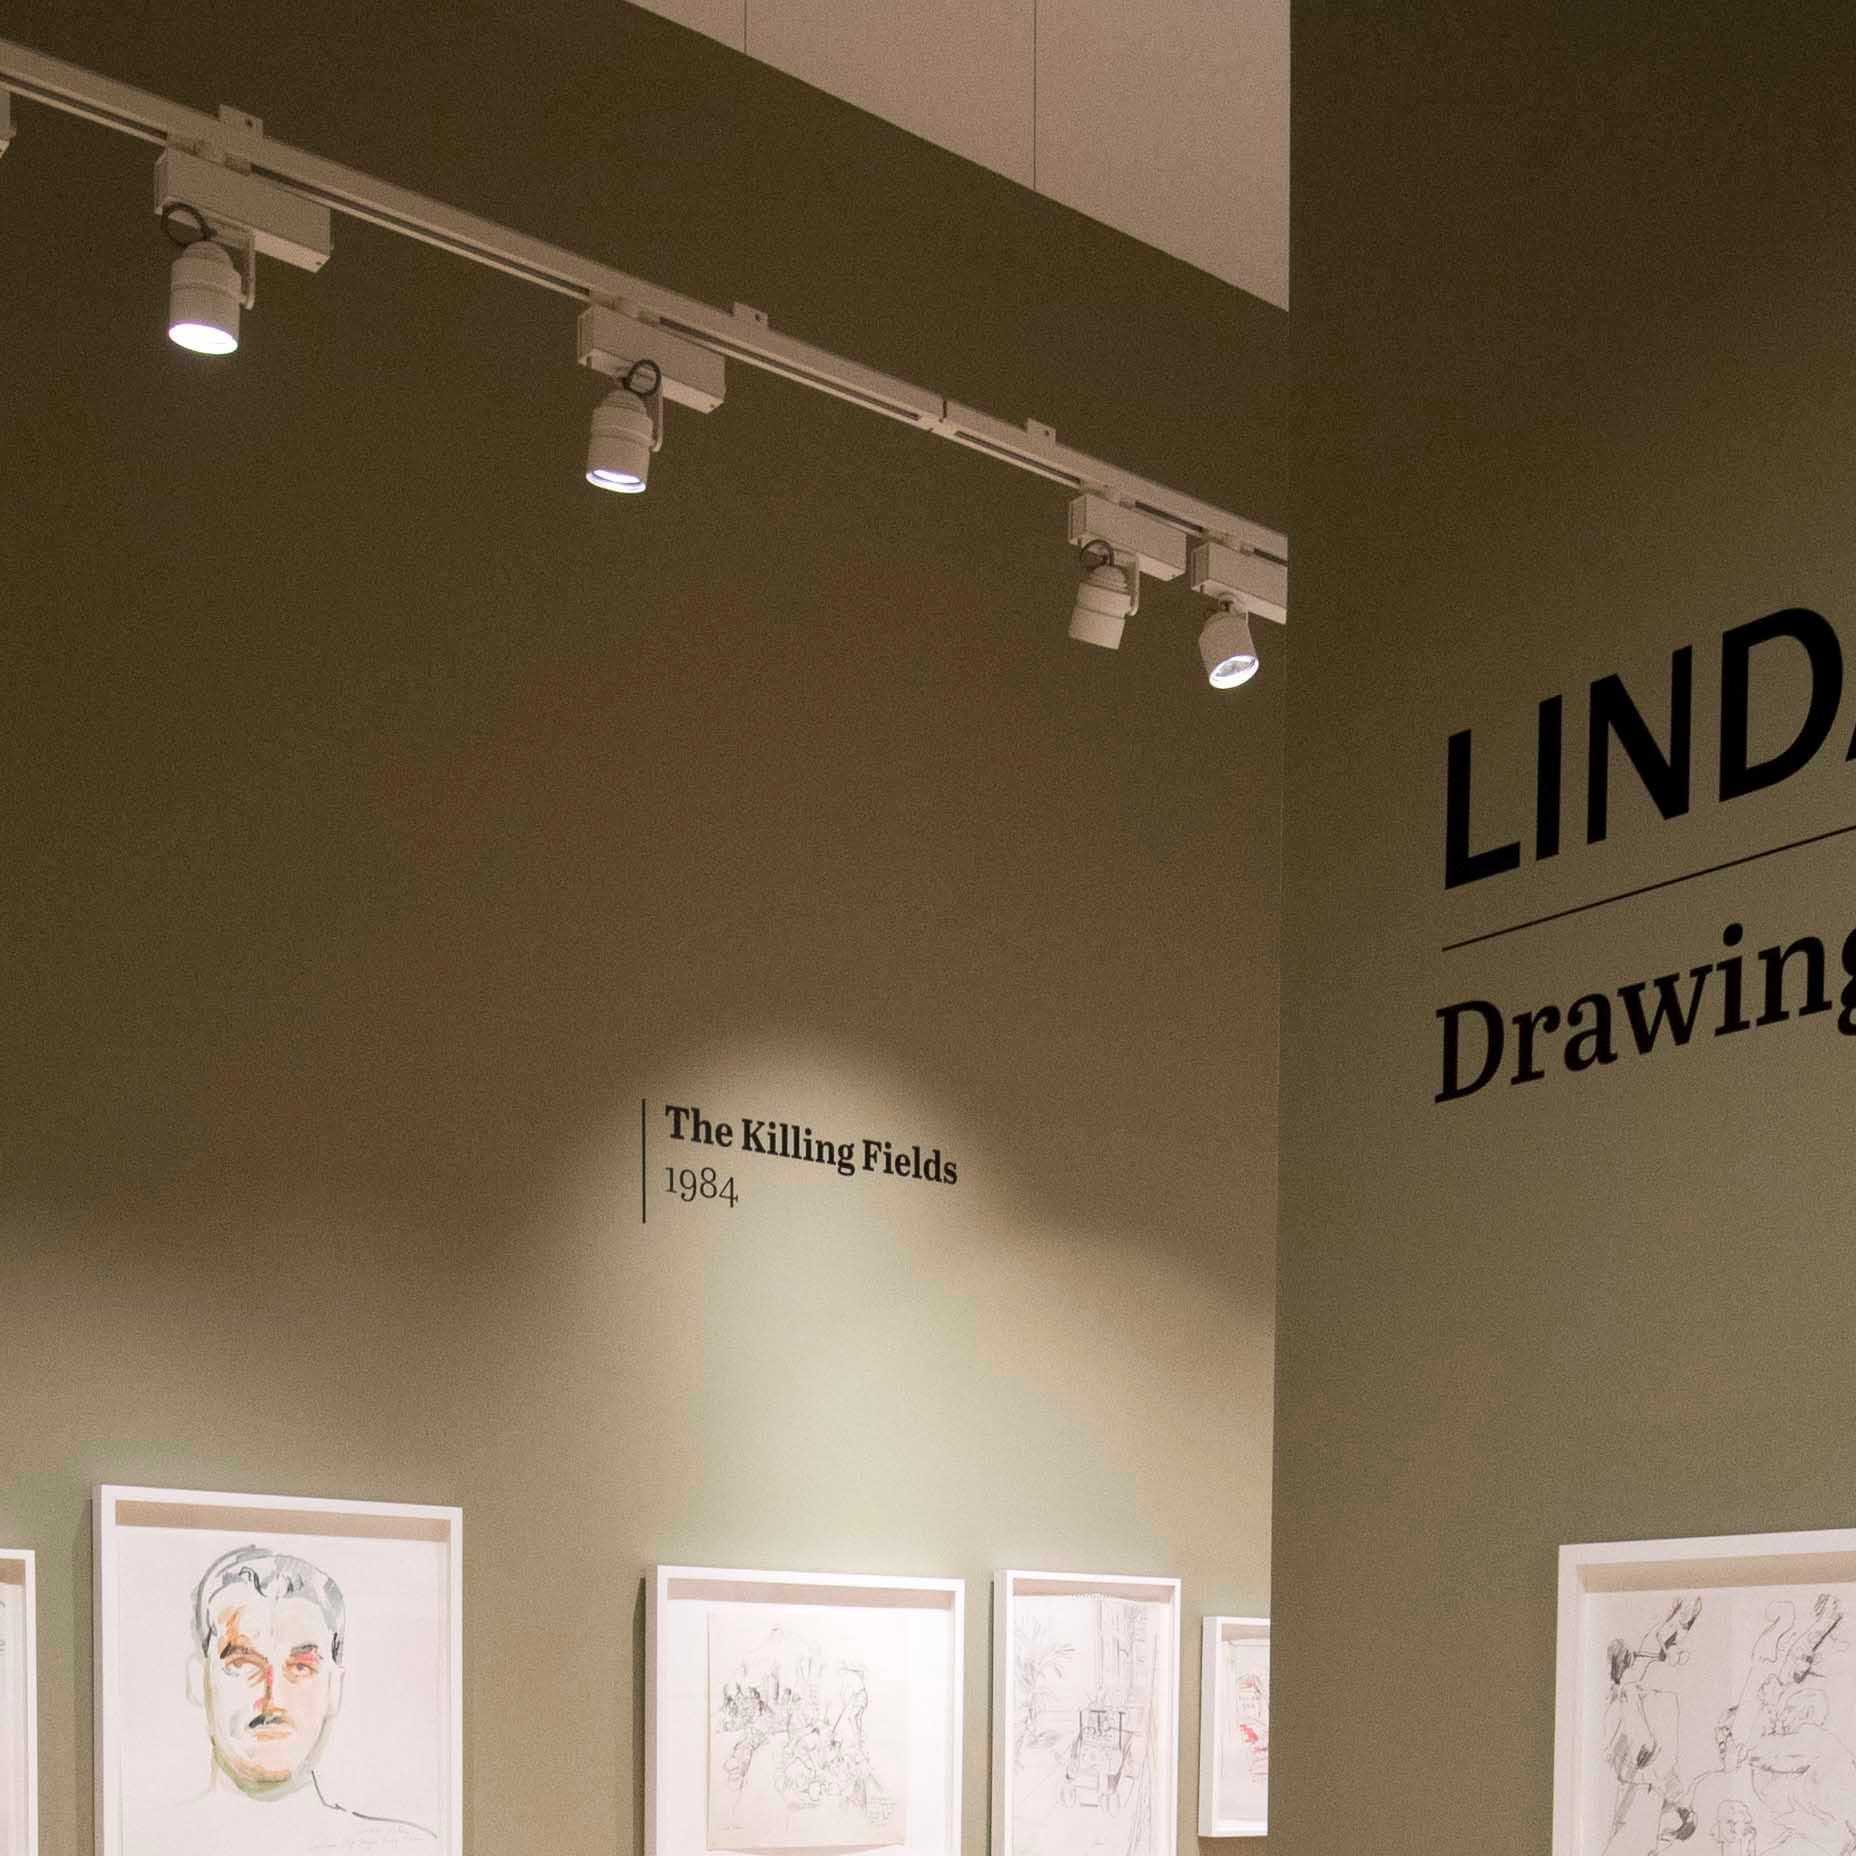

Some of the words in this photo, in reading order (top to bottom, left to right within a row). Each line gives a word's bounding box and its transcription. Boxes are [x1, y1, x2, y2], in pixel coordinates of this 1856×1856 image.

[664, 1104, 734, 1148] The
[741, 1118, 856, 1177] Killing
[862, 1139, 958, 1186] Fields
[664, 1166, 739, 1208] 1984
